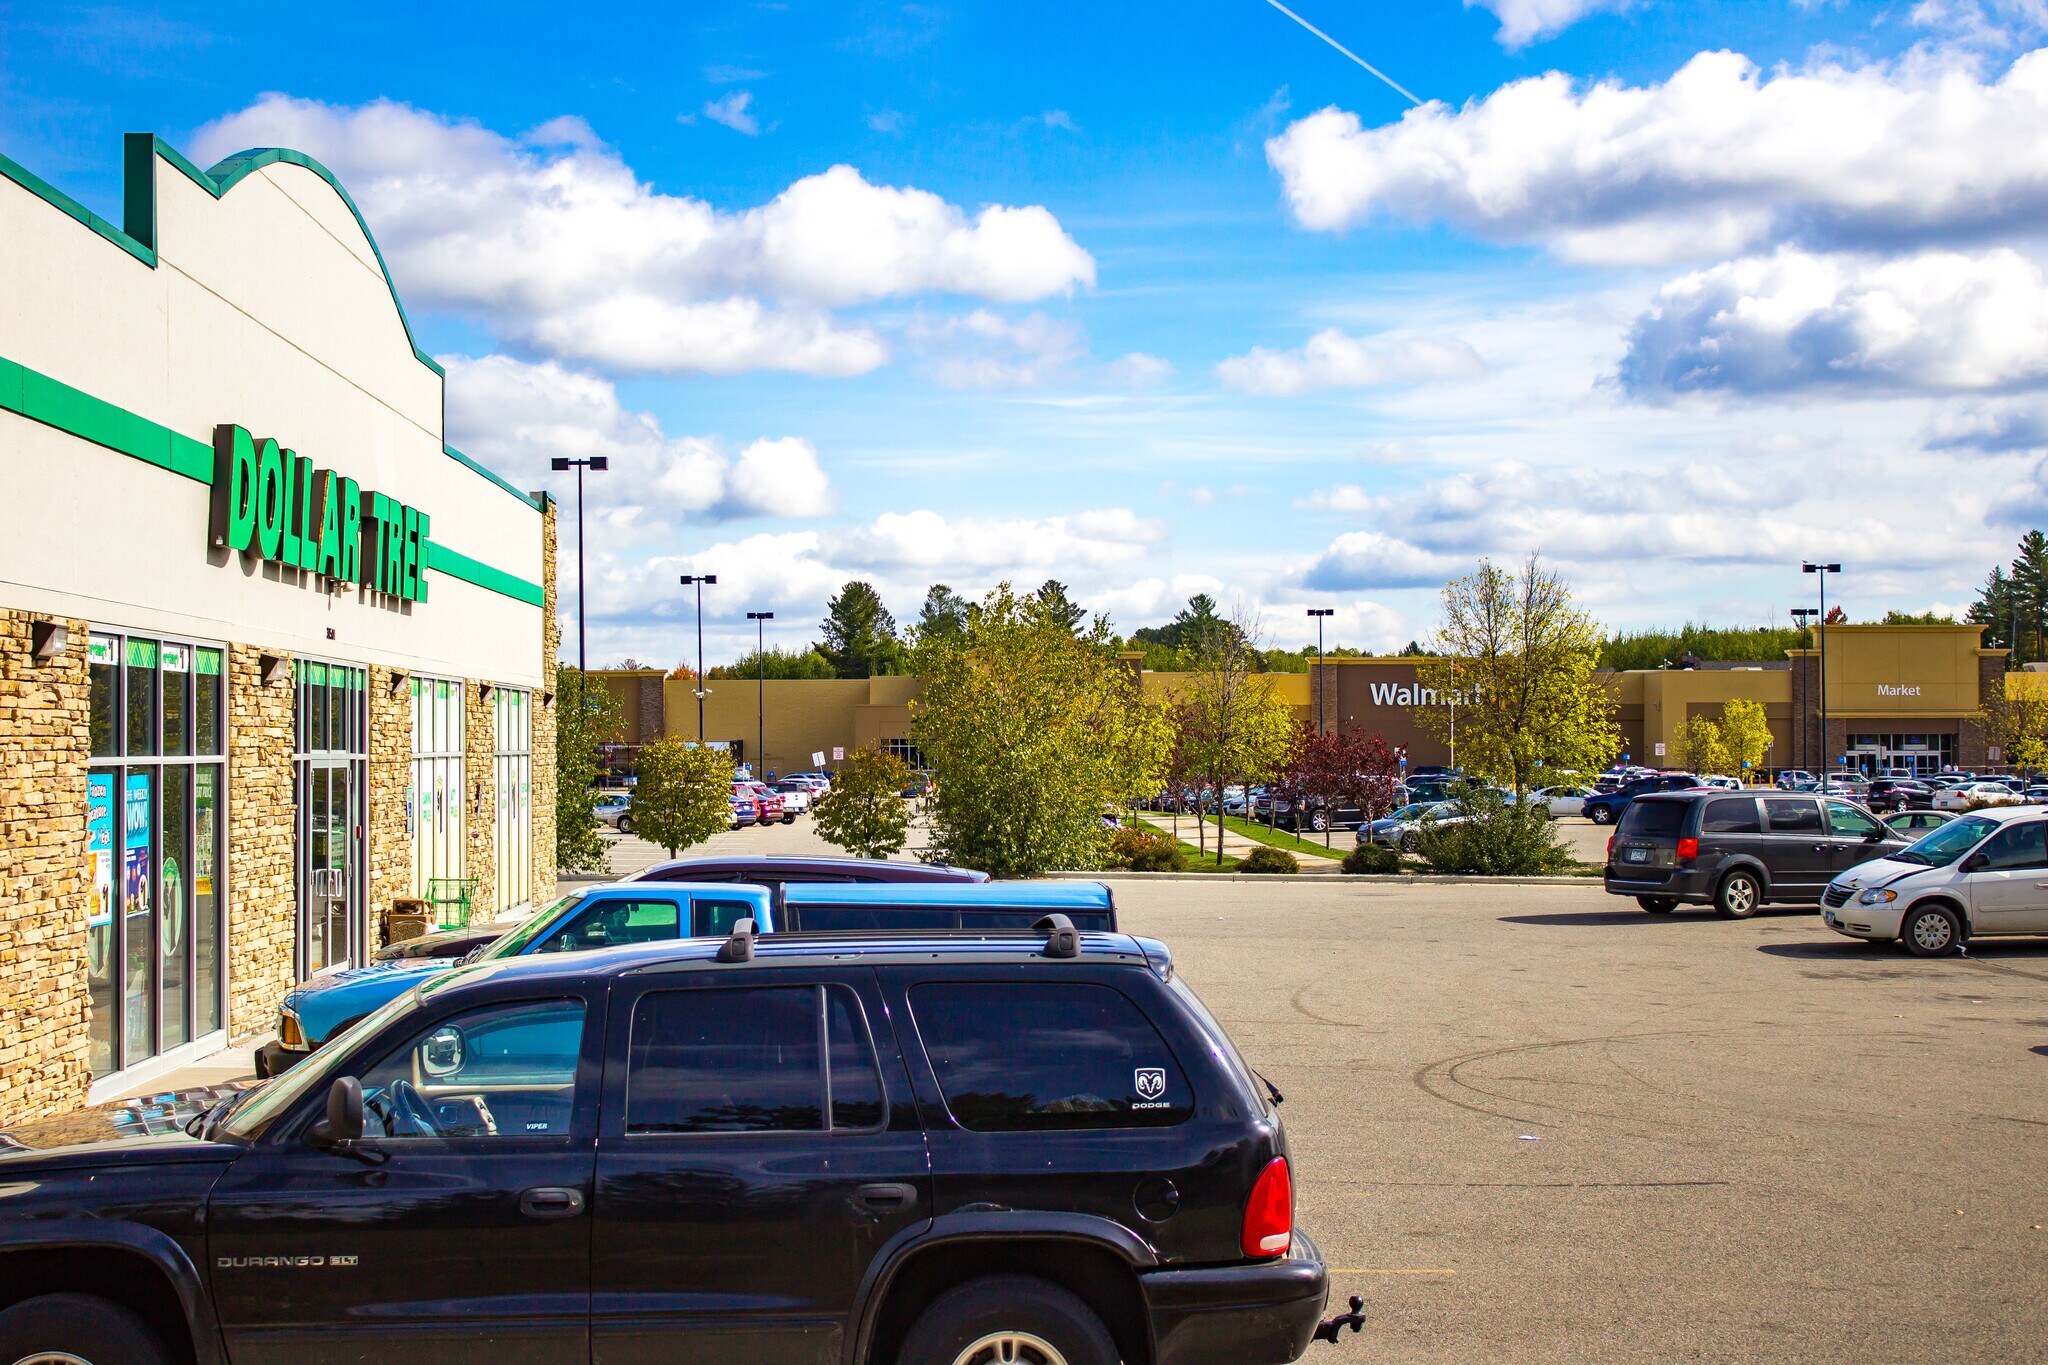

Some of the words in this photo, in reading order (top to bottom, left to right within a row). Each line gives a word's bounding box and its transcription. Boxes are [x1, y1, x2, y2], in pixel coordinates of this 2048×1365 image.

[218, 424, 360, 583] DOLLAR
[361, 491, 430, 603] TREE
[1877, 684, 1921, 696] Market
[526, 1122, 548, 1130] VIPER
[217, 1255, 325, 1267] DURANGO
[329, 1255, 359, 1266] SLT
